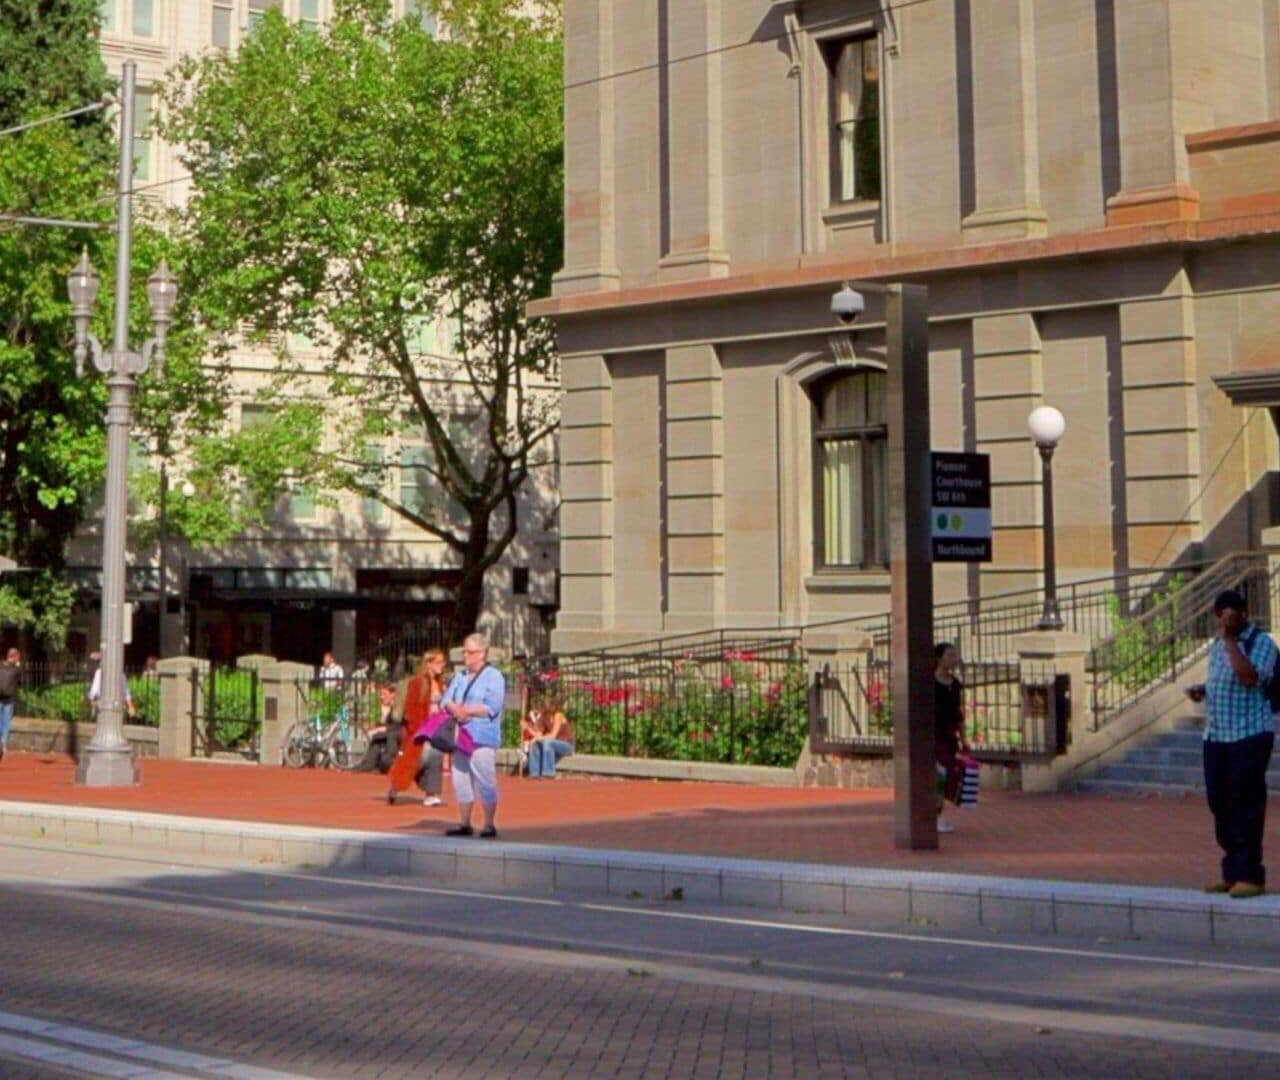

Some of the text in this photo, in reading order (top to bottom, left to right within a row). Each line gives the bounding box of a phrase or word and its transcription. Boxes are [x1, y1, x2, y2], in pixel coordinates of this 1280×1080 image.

[936, 461, 968, 472] Pioneer
[936, 476, 983, 488] Courthouse
[937, 544, 986, 556] Northbound
